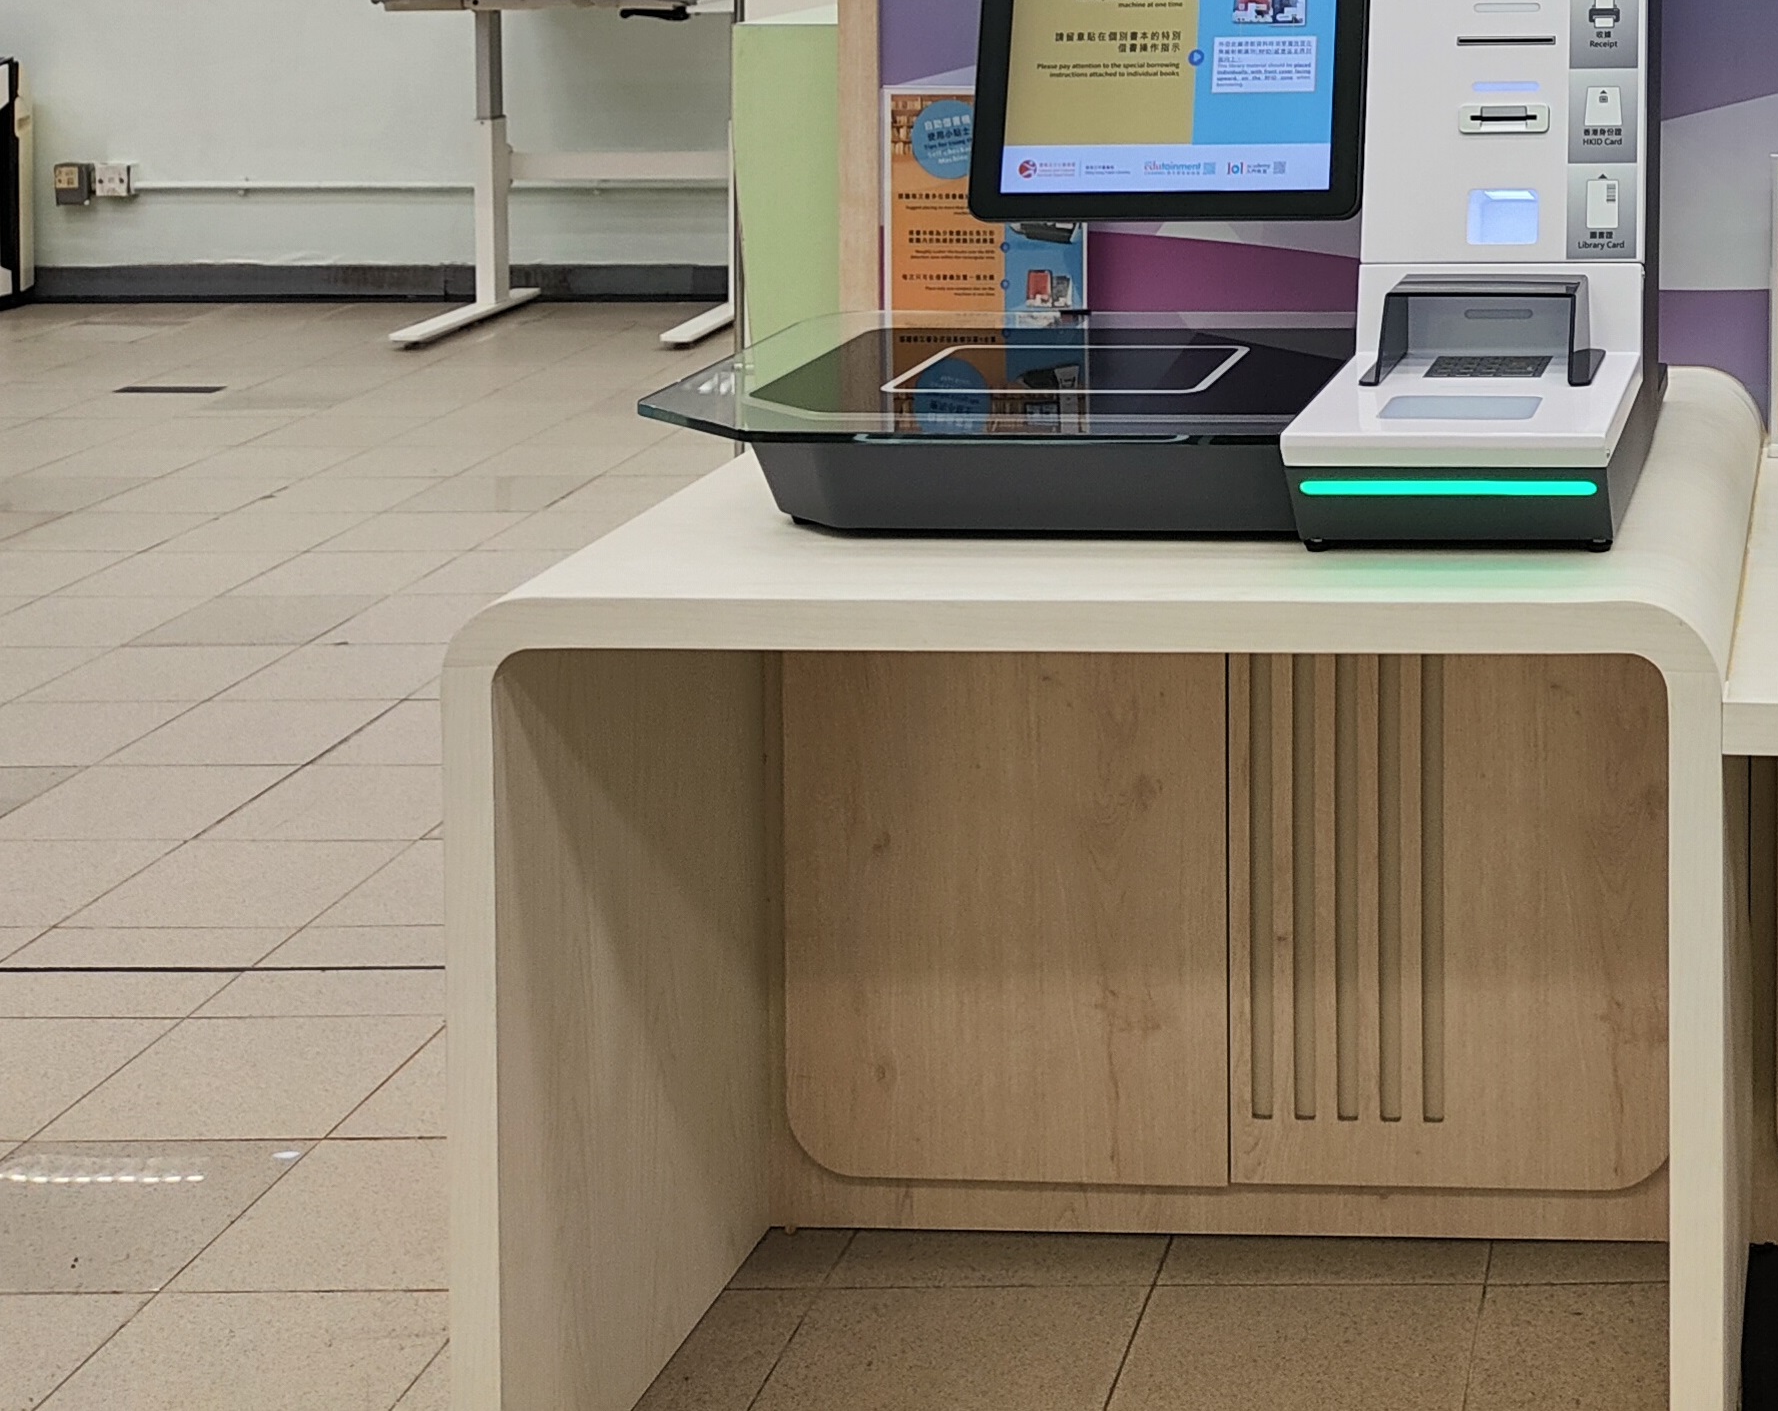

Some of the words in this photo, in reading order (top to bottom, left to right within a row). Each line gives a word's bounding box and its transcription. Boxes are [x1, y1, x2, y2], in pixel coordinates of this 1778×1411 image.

[1589, 40, 1618, 49] Receipt
[1583, 129, 1622, 137] 香港身份證
[1582, 138, 1602, 146] HKID
[1604, 138, 1622, 146] Card
[1578, 240, 1605, 250] Library
[1607, 240, 1625, 249] Card
